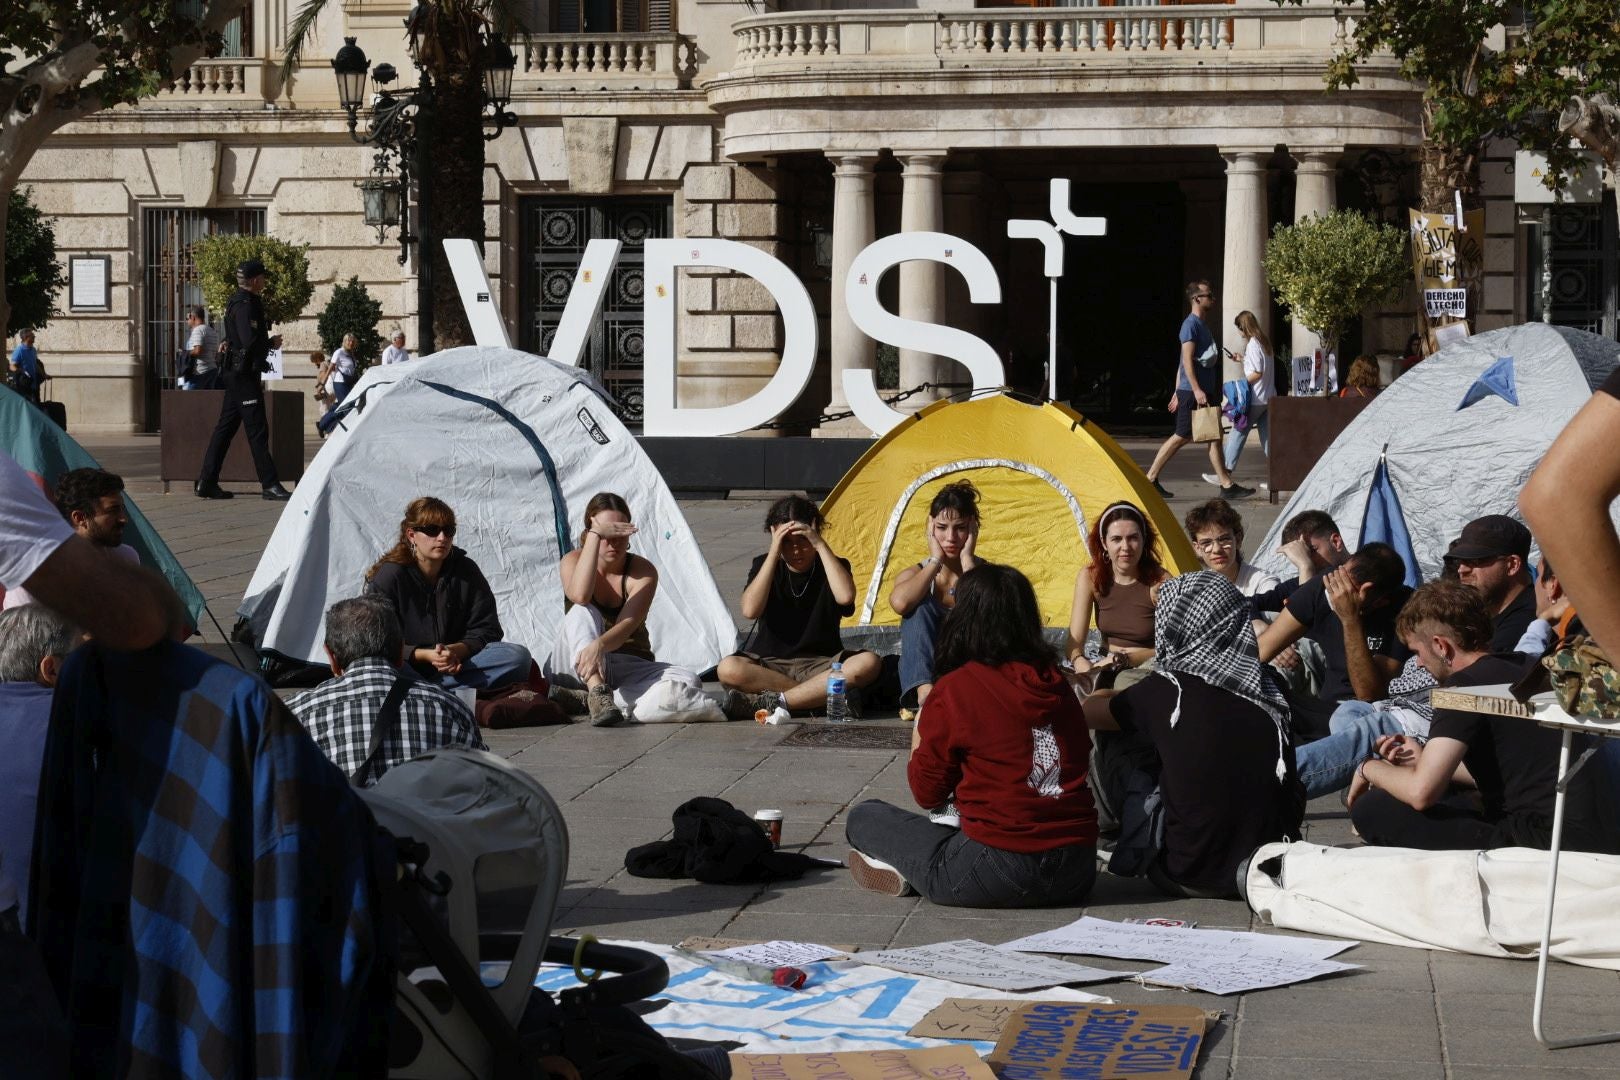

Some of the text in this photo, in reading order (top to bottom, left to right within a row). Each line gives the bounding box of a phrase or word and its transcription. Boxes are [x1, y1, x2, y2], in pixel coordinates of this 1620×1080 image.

[1426, 291, 1465, 300] DERECHO
[1427, 301, 1465, 309] A TECHO
[1112, 1022, 1191, 1074] VIDES!!
